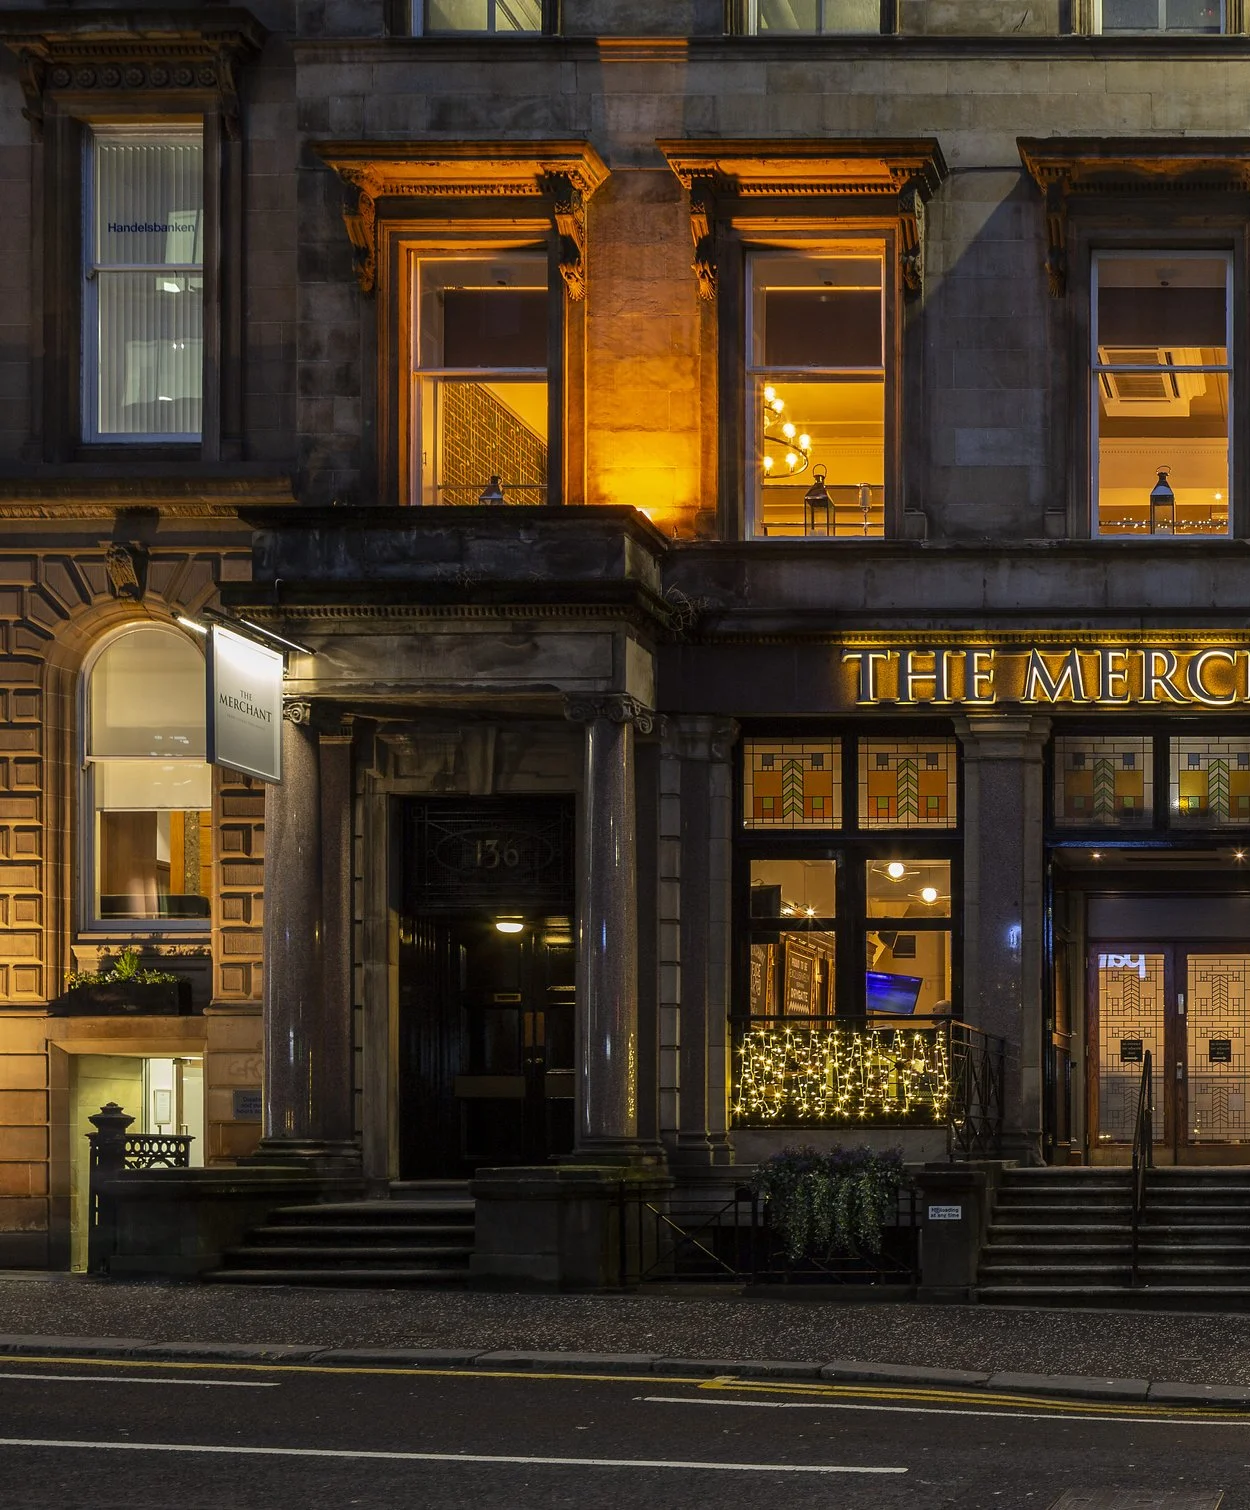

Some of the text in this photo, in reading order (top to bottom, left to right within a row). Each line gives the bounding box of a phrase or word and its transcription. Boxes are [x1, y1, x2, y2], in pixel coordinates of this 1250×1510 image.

[108, 222, 195, 233] Handelsbanken
[841, 649, 996, 705] THE
[240, 689, 253, 702] THE
[219, 692, 273, 723] MERCHANT
